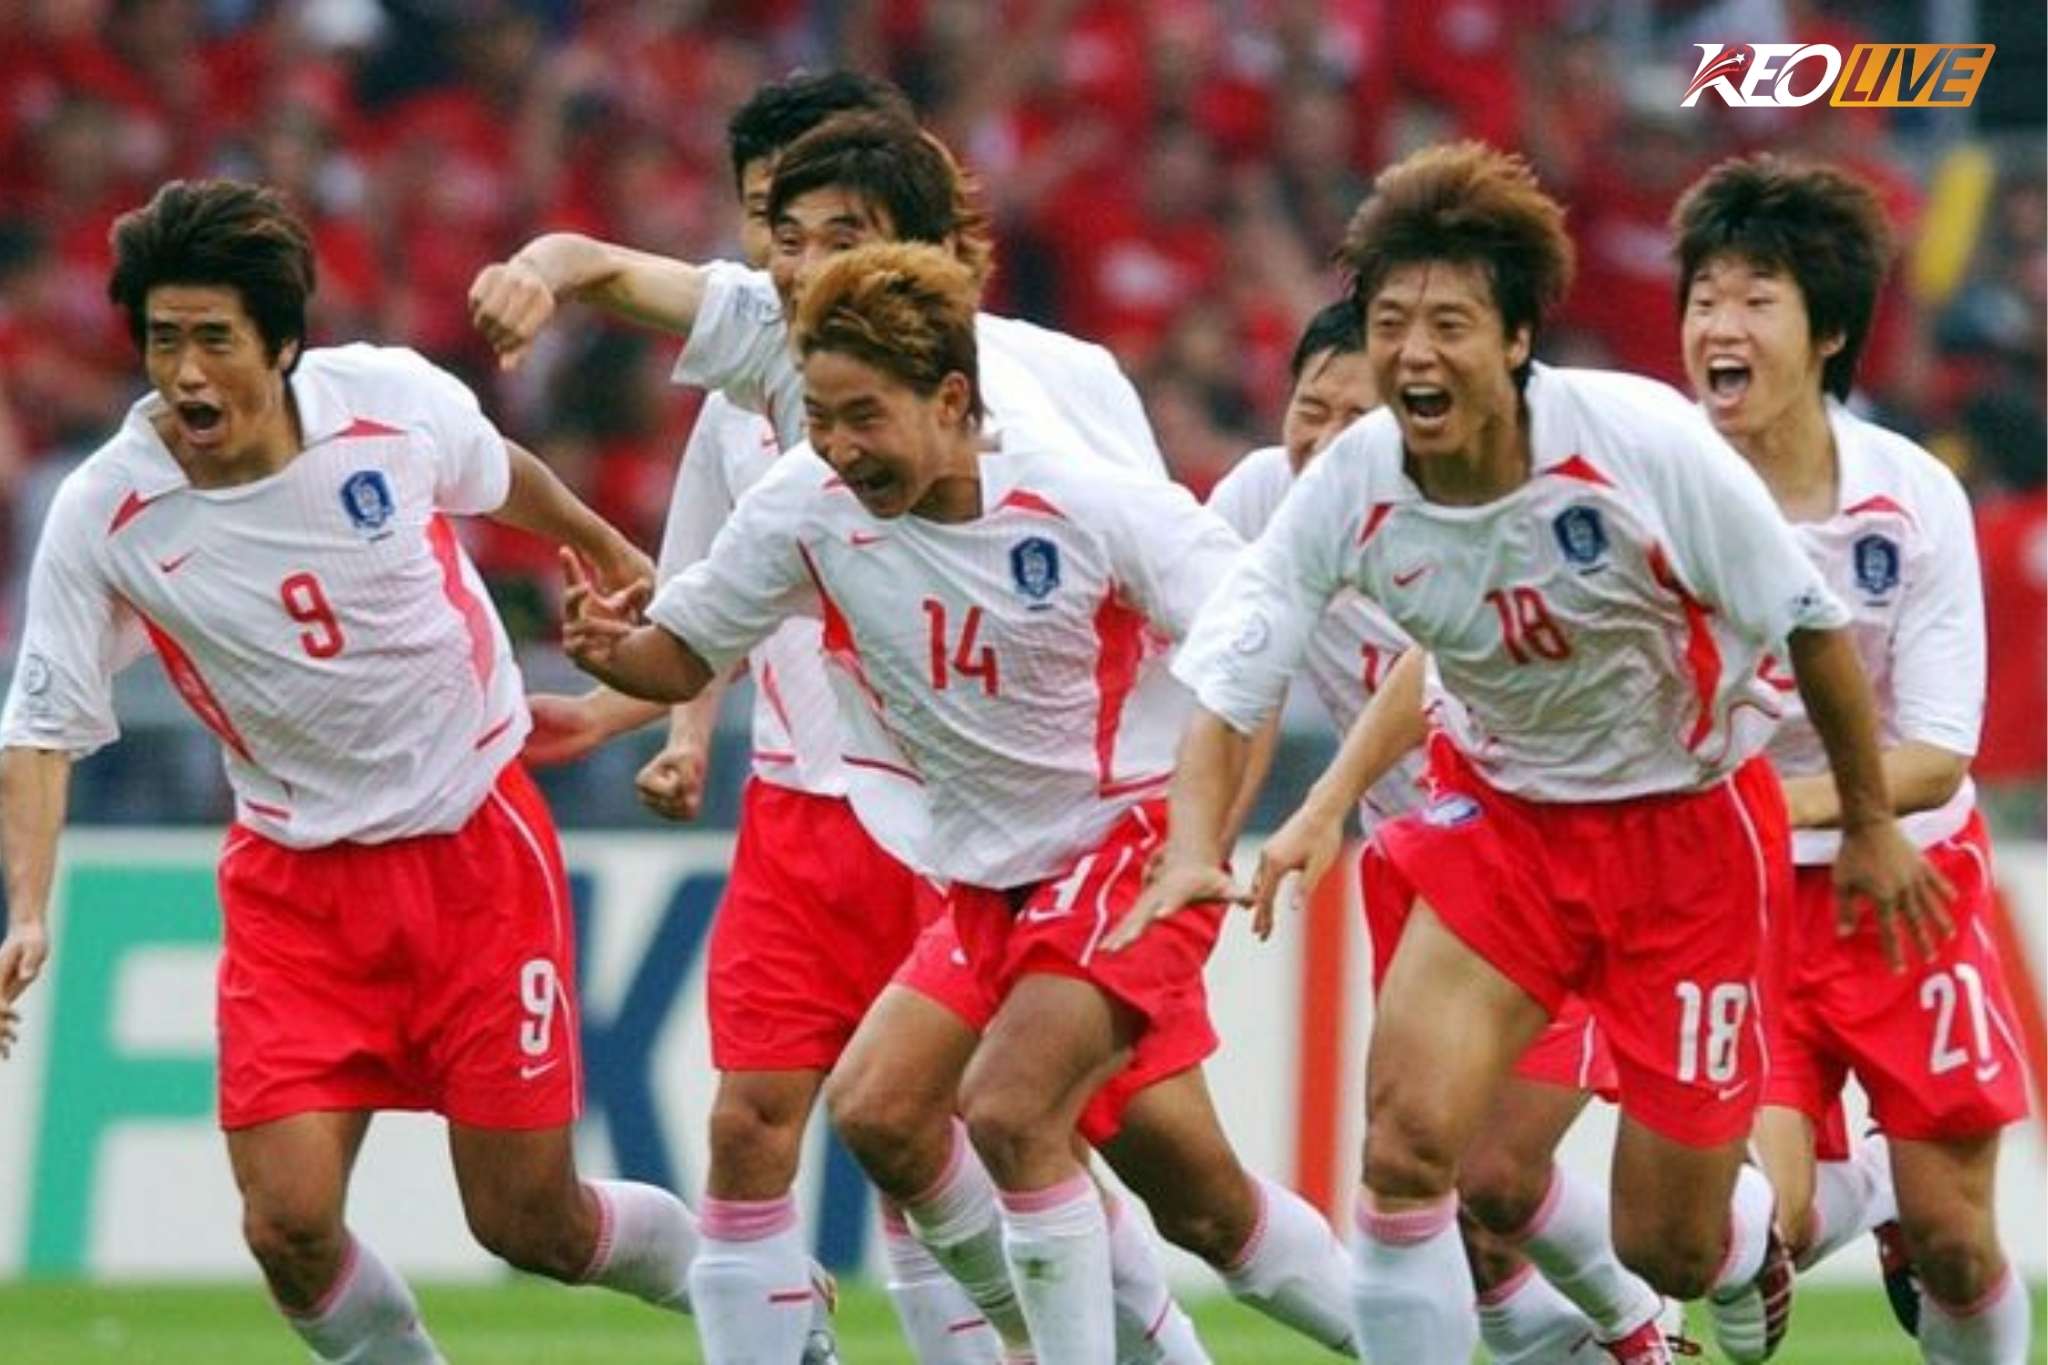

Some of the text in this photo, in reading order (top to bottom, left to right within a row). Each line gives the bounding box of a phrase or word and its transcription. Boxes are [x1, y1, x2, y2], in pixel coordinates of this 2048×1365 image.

[280, 570, 345, 659] 9
[922, 598, 999, 697] 14
[1484, 586, 1572, 666] 18
[519, 958, 556, 1056] 9
[1674, 979, 1749, 1084] 18
[1920, 962, 1992, 1075] 21
